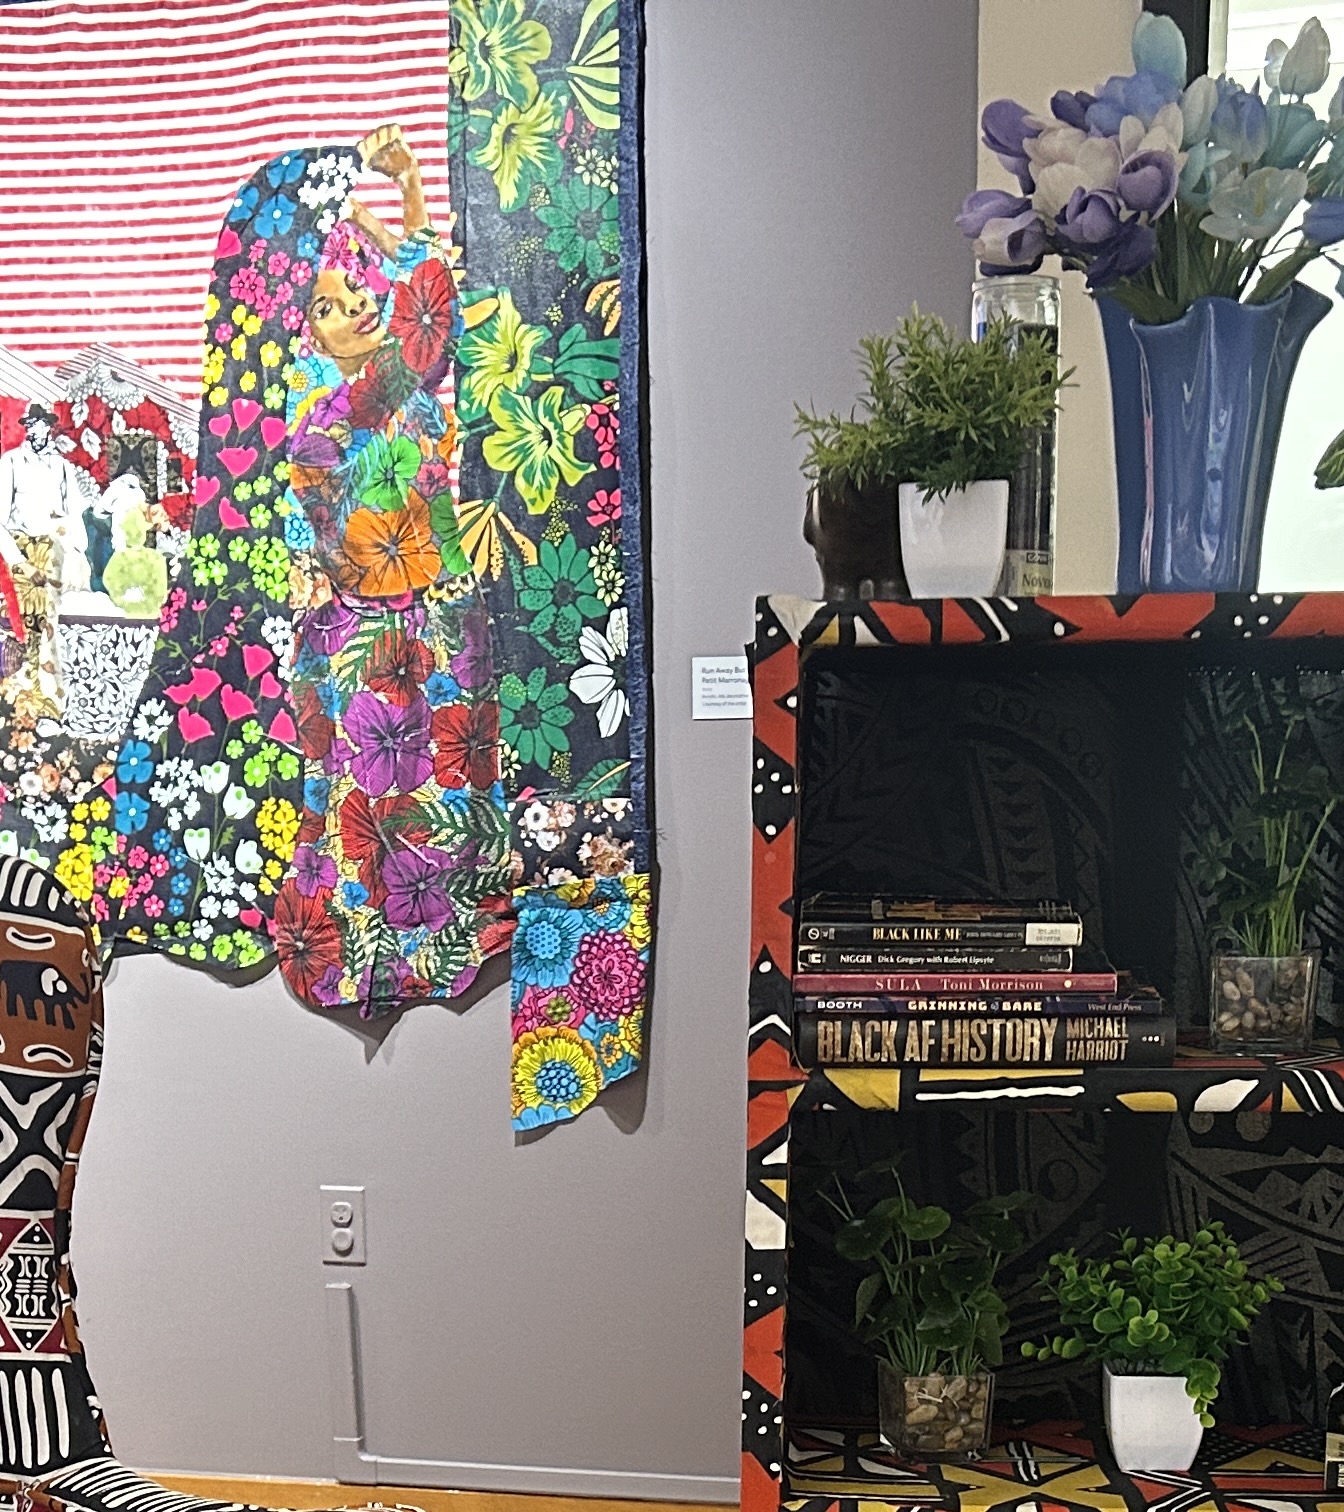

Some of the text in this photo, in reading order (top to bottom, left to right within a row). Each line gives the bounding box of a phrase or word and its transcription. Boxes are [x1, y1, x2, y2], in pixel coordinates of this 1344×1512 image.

[872, 927, 961, 941] BLACK LIKE ME
[840, 954, 873, 963] NIGGER
[878, 954, 894, 963] Dick
[896, 955, 925, 966] Gregory
[926, 955, 942, 964] with
[944, 956, 968, 964] Robert
[875, 978, 1043, 991] SULA Toni Morrison
[817, 1001, 863, 1010] BOOTH
[907, 1000, 987, 1011] GRINNING
[1002, 1001, 1042, 1011] BARE
[1087, 1003, 1106, 1011] West
[1107, 1002, 1121, 1011] End
[1123, 1002, 1142, 1011] Press
[1066, 1016, 1129, 1038] MICHAEL
[817, 1018, 1058, 1063] BLACK AF HISTORY
[1066, 1039, 1129, 1062] HARRIOT
